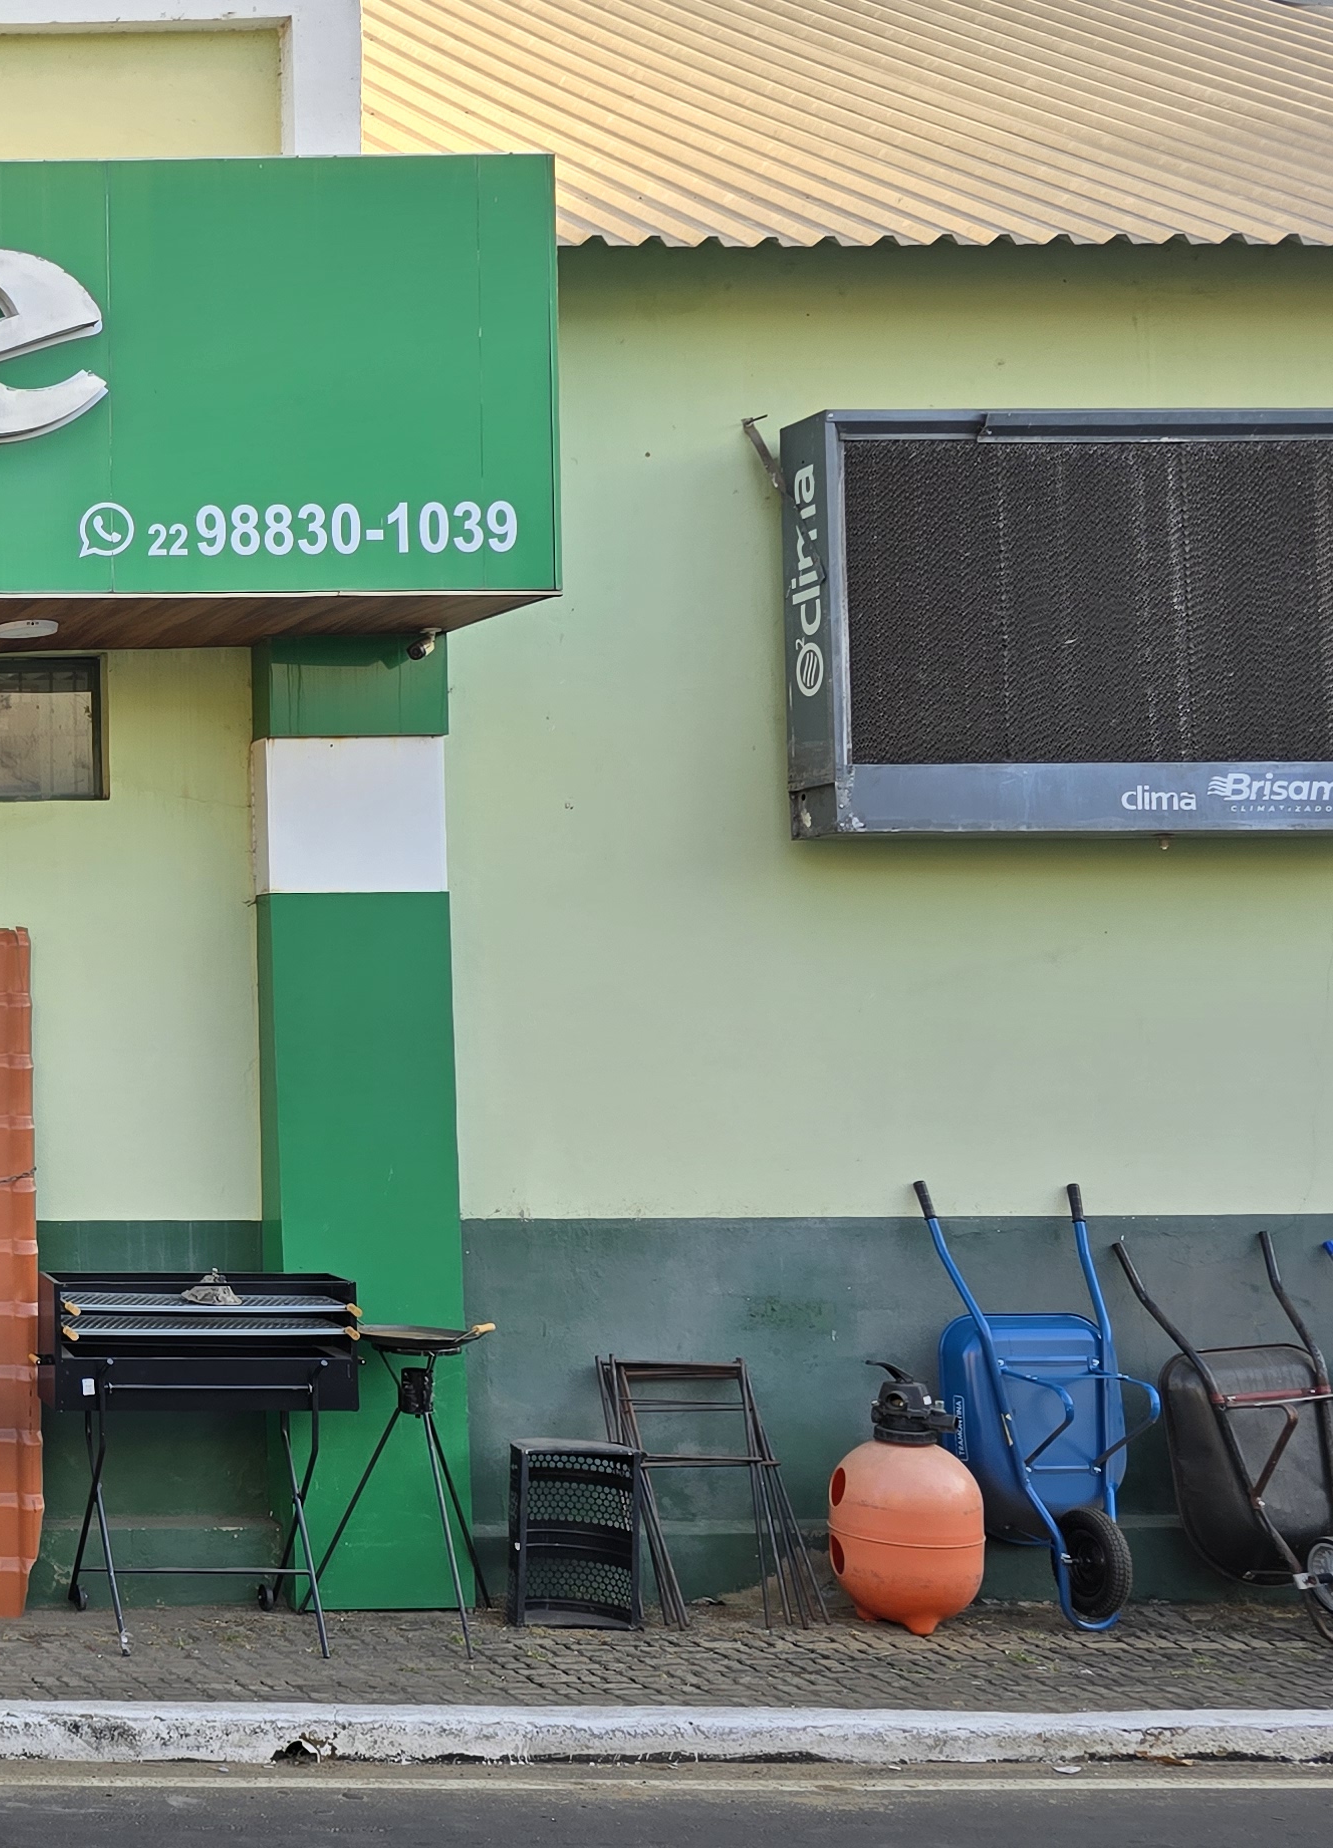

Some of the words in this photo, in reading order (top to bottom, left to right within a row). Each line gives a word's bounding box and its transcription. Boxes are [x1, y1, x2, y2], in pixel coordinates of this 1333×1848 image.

[147, 523, 189, 556] 22
[195, 500, 518, 556] 98830-1039
[1121, 785, 1197, 811] clima
